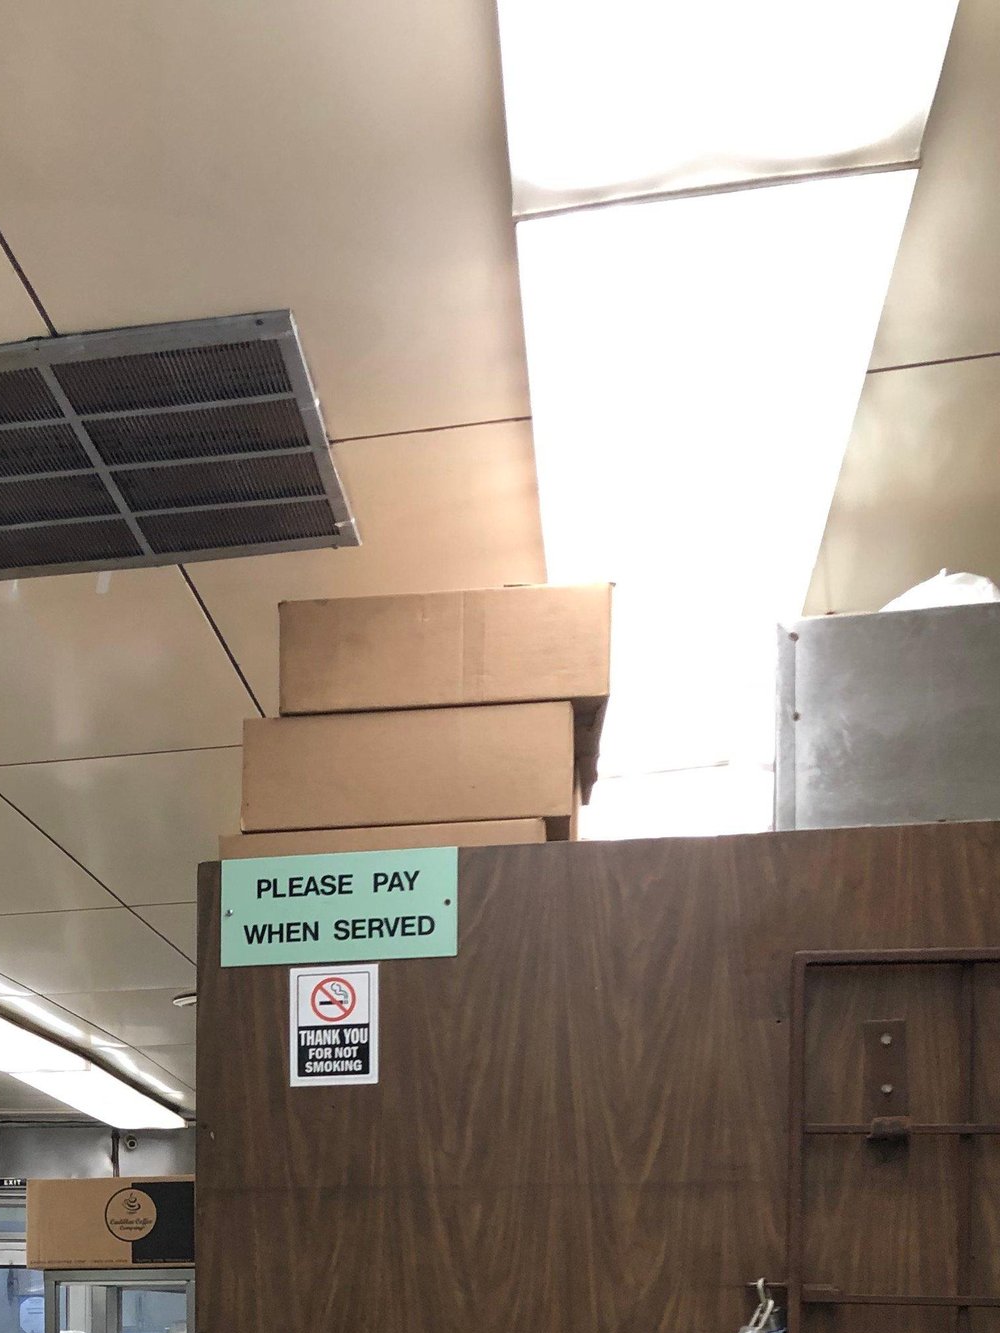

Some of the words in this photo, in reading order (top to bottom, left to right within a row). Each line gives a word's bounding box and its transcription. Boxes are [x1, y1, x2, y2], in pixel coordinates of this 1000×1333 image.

[257, 874, 353, 899] PLEASE
[373, 870, 420, 893] PAY
[244, 921, 319, 945] WHEN
[333, 915, 435, 941] SERVED
[299, 1029, 341, 1047] THANK
[343, 1027, 369, 1045] YOU
[308, 1047, 333, 1060] FOR
[334, 1046, 359, 1058] NOT
[305, 1060, 363, 1073] SMOKING
